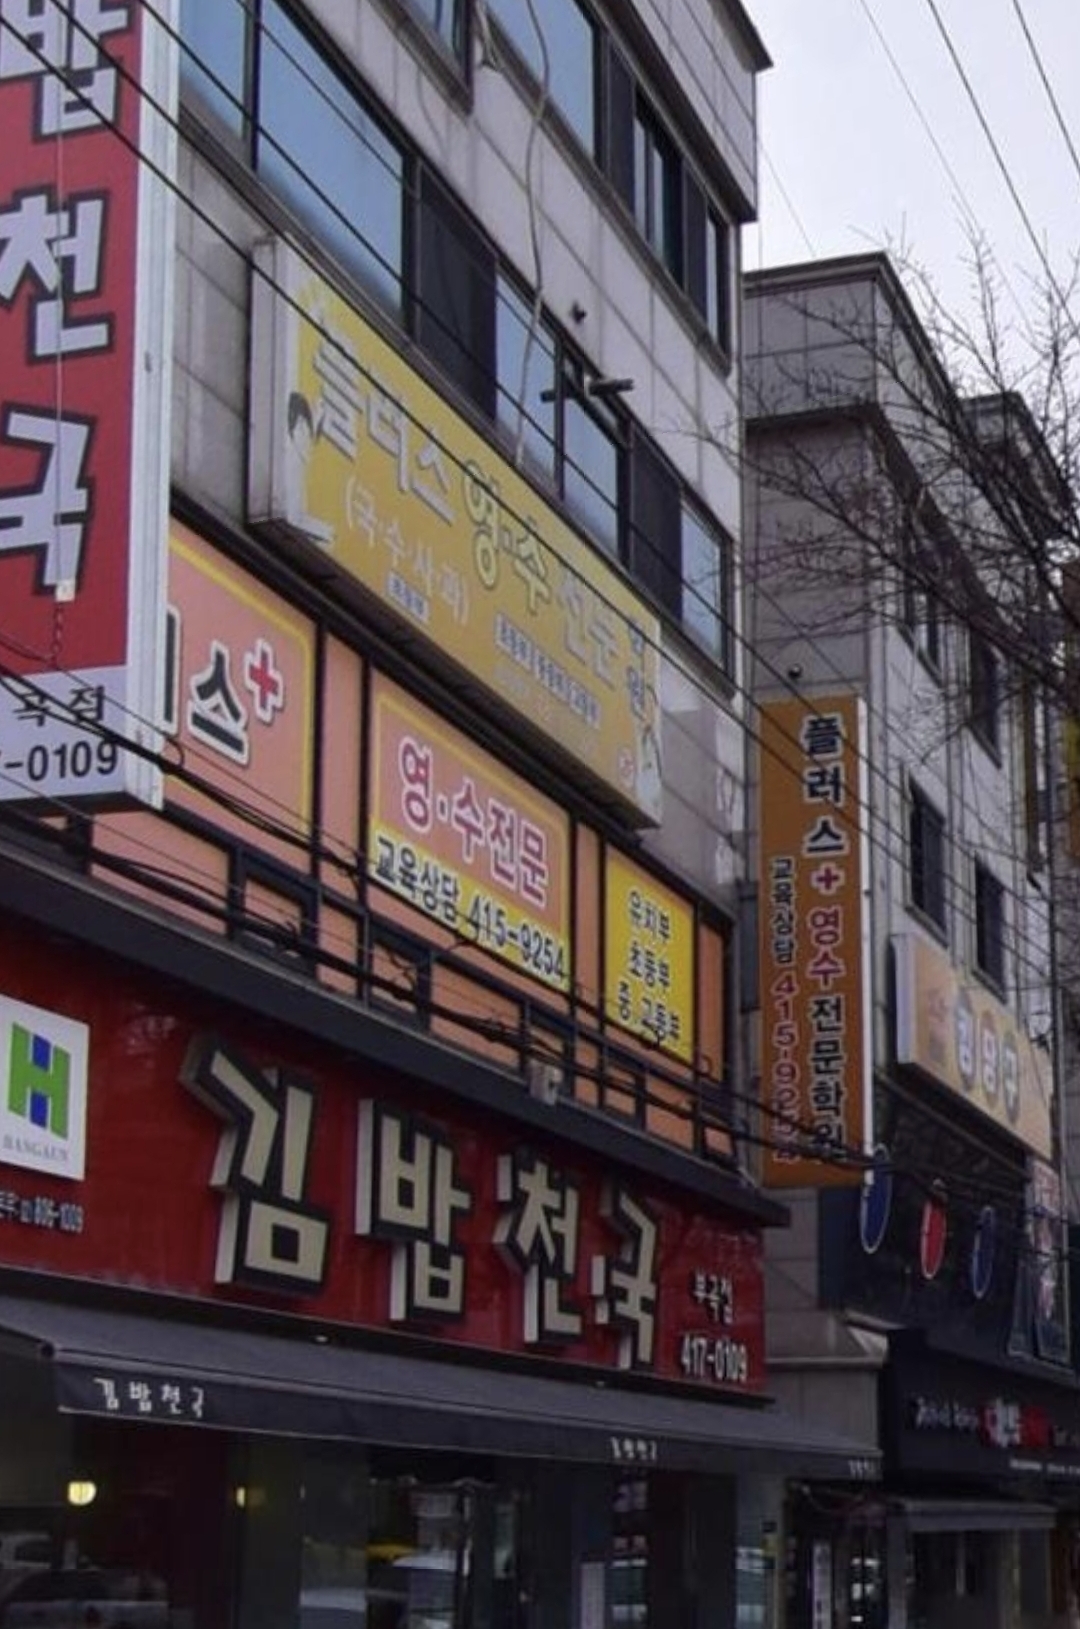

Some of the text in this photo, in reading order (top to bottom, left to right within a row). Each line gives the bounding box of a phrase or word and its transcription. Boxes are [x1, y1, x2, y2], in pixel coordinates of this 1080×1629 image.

[0, 735, 118, 782] -0109
[803, 714, 847, 855] 플러스
[376, 834, 567, 978] 교육상담 415-9254
[630, 938, 671, 992] 초등부
[180, 1035, 660, 1372] 김밥천국
[680, 1333, 748, 1386] 417-0109
